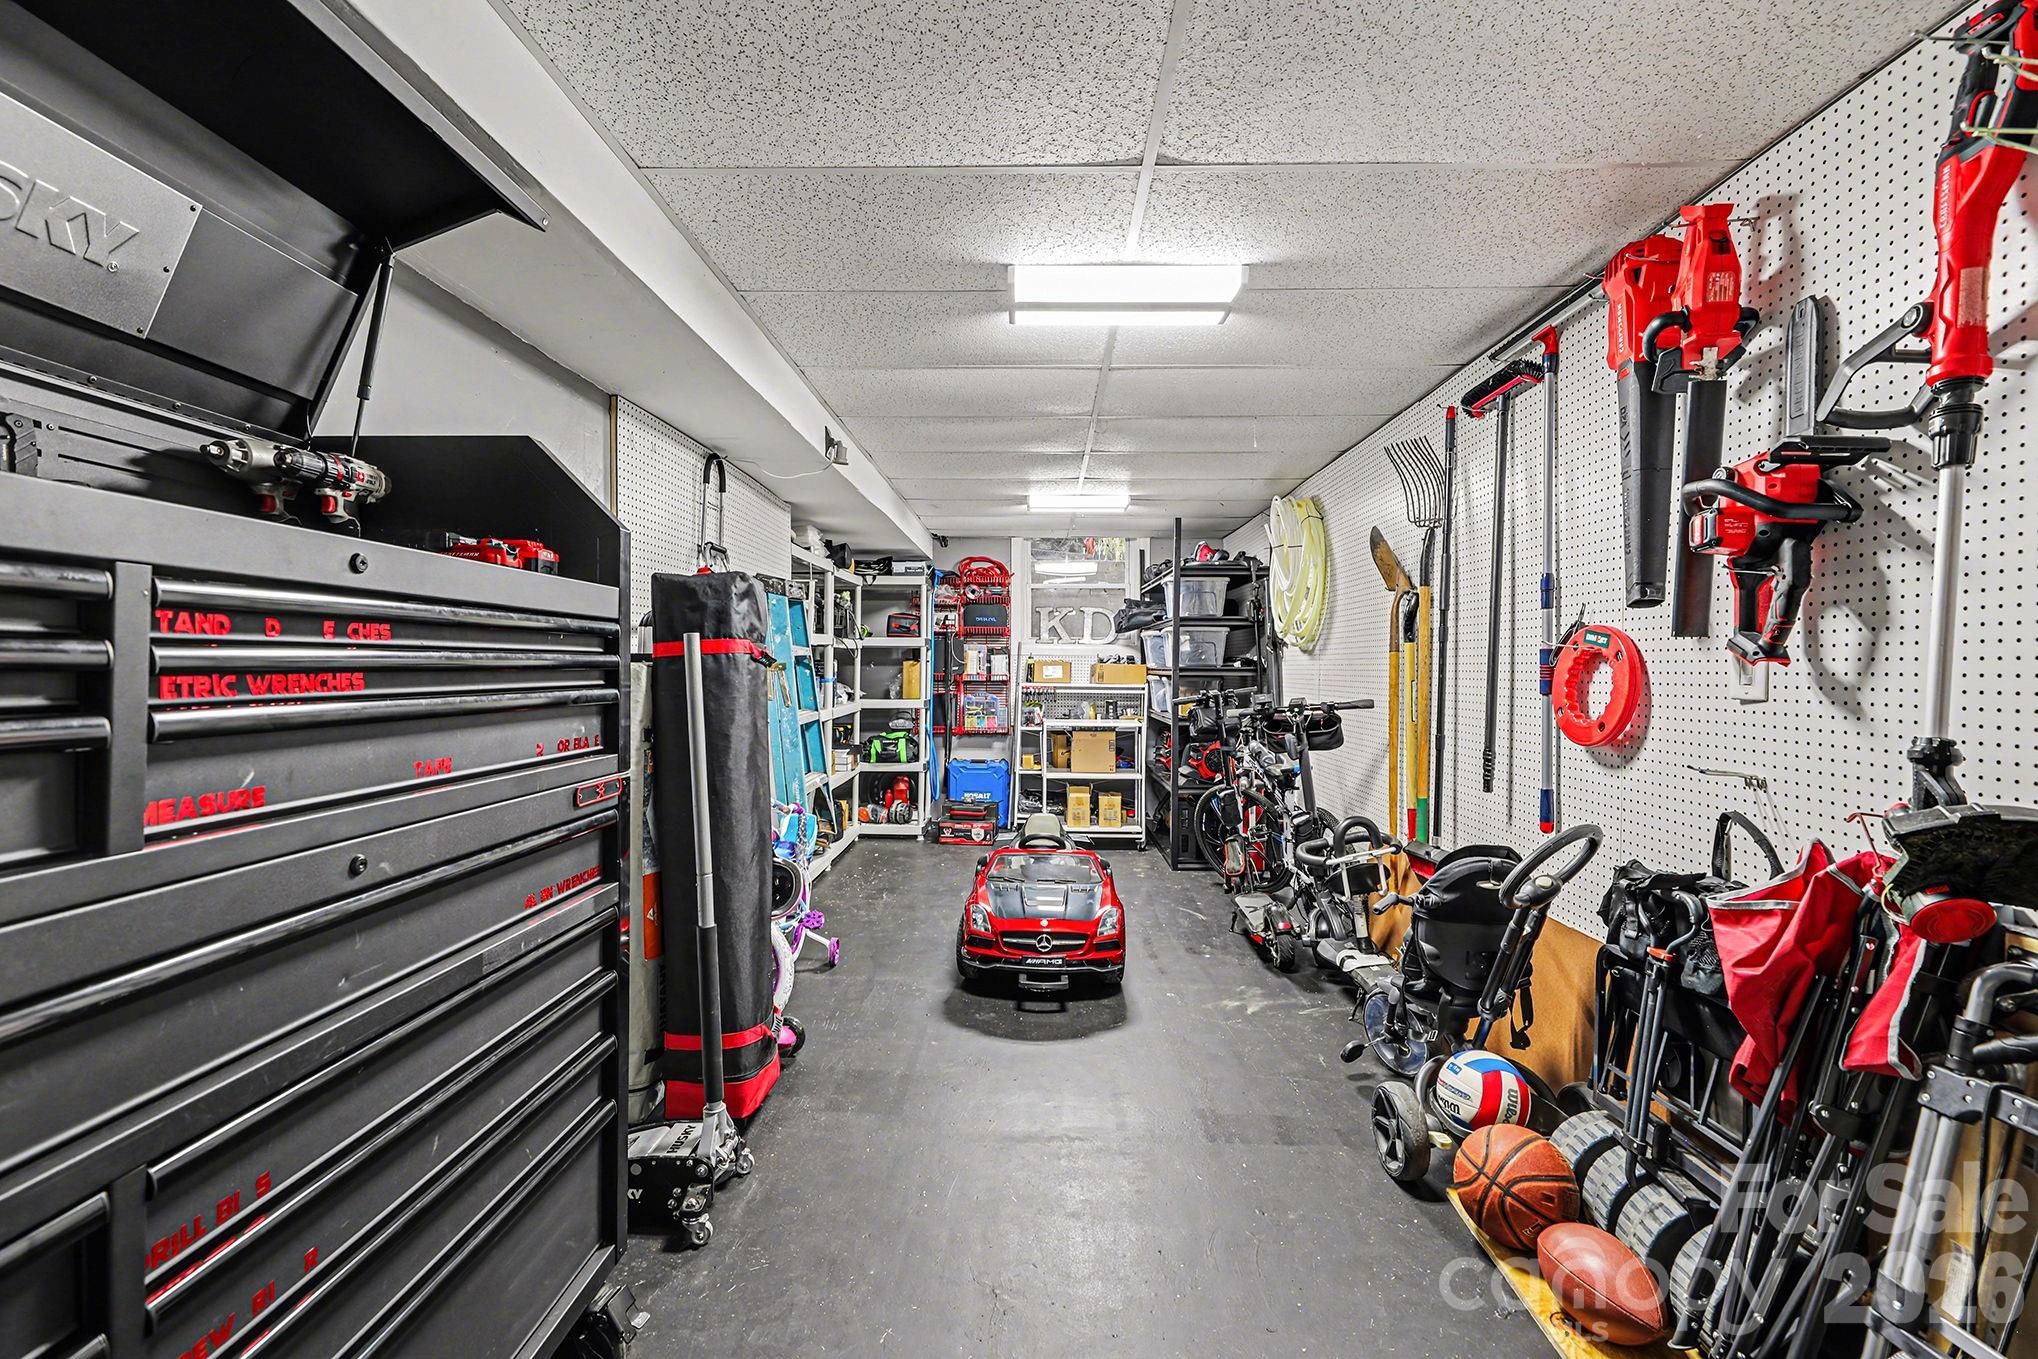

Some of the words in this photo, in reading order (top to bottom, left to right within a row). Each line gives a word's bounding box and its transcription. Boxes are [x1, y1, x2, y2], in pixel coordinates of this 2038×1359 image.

[246, 672, 366, 696] WRENCHES
[144, 786, 266, 826] MEASURE
[666, 1125, 697, 1154] HUSKY
[145, 1215, 207, 1270] RILL
